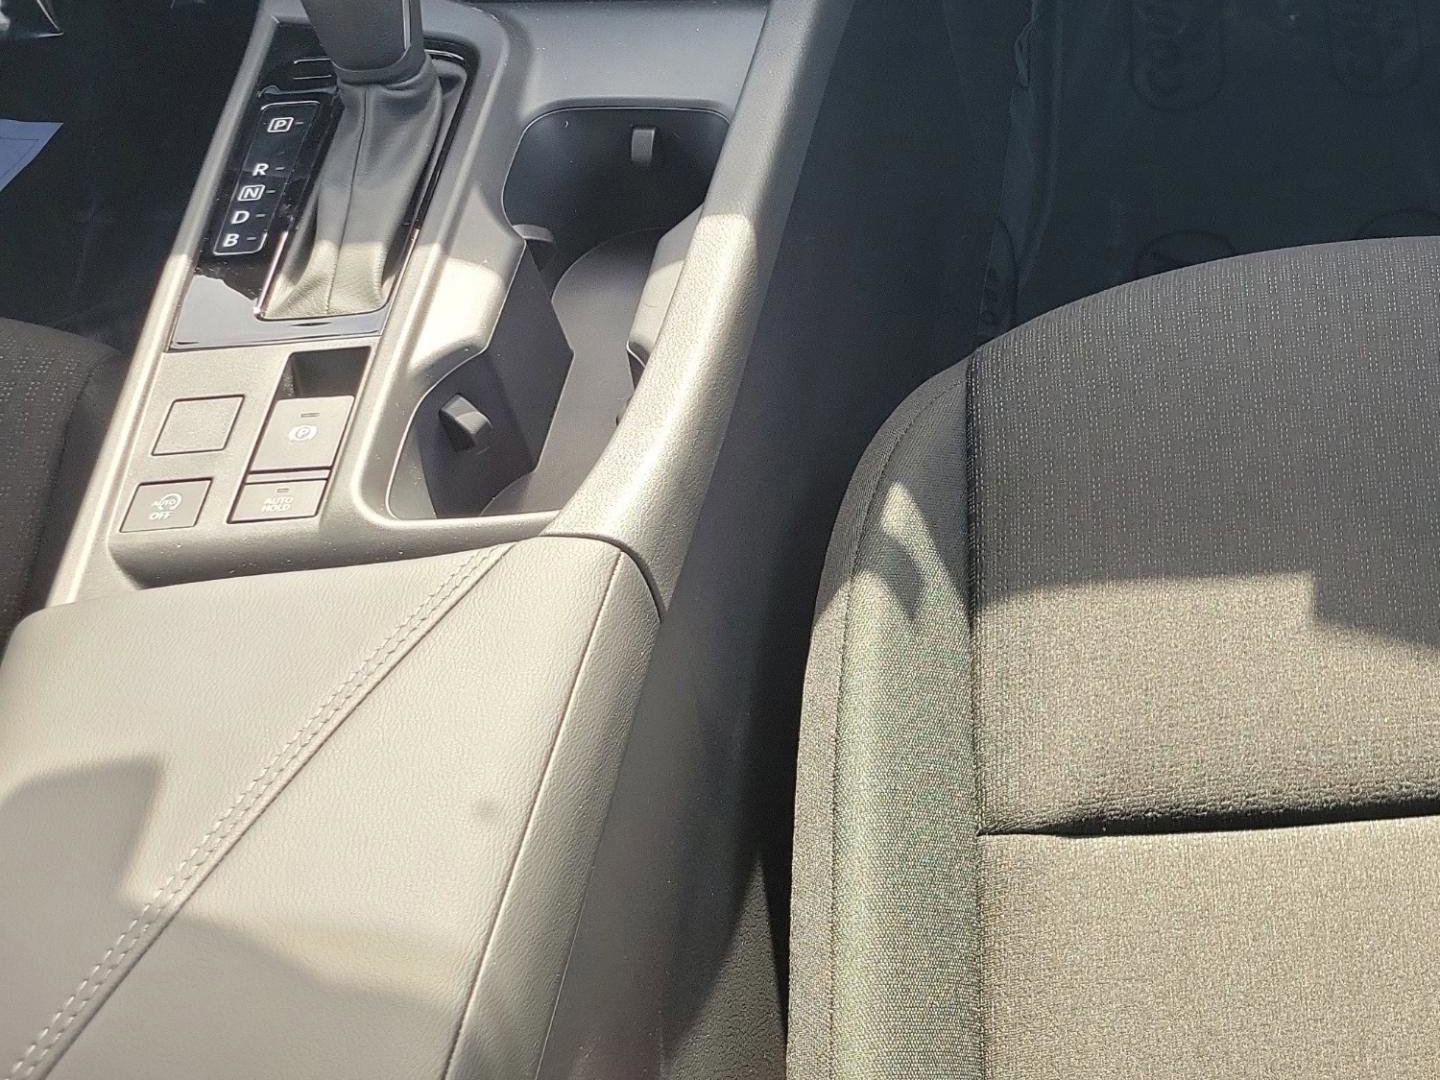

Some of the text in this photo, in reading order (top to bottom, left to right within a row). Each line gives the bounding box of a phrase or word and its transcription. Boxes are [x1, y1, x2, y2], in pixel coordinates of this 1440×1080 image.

[273, 120, 288, 130] P
[252, 163, 269, 177] R
[243, 188, 260, 198] N
[231, 211, 250, 224] D
[222, 234, 239, 247] B
[264, 496, 294, 505] AUTO
[261, 503, 292, 513] HOLD
[149, 511, 172, 520] OFF
